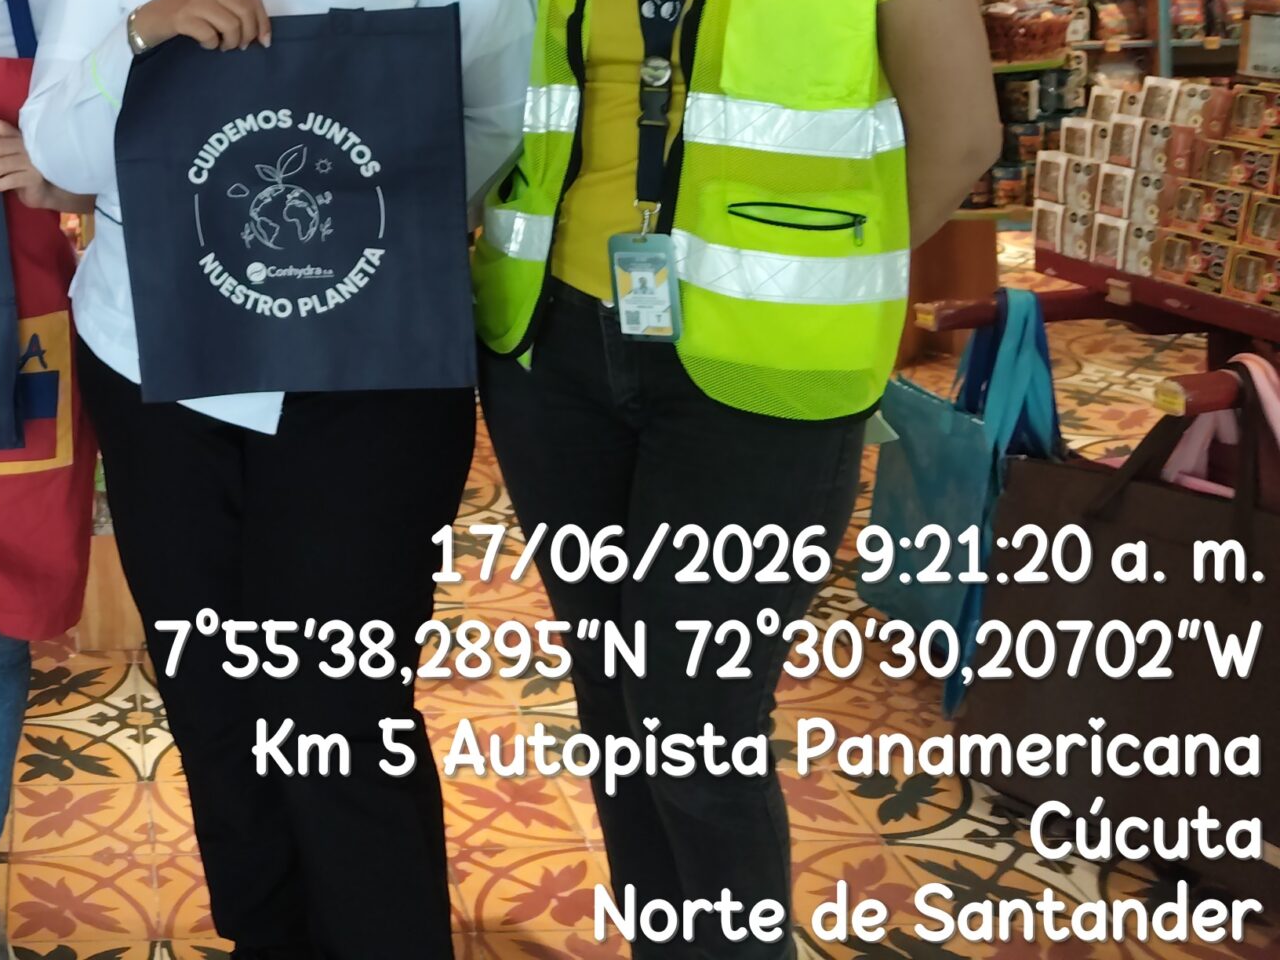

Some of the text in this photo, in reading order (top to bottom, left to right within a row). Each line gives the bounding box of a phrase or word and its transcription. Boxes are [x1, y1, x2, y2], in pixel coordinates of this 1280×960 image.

[187, 108, 382, 185] CUIDEMOS JUNTOS
[198, 247, 386, 318] NUESTRO PLANETA
[266, 264, 322, 280] Conhydra
